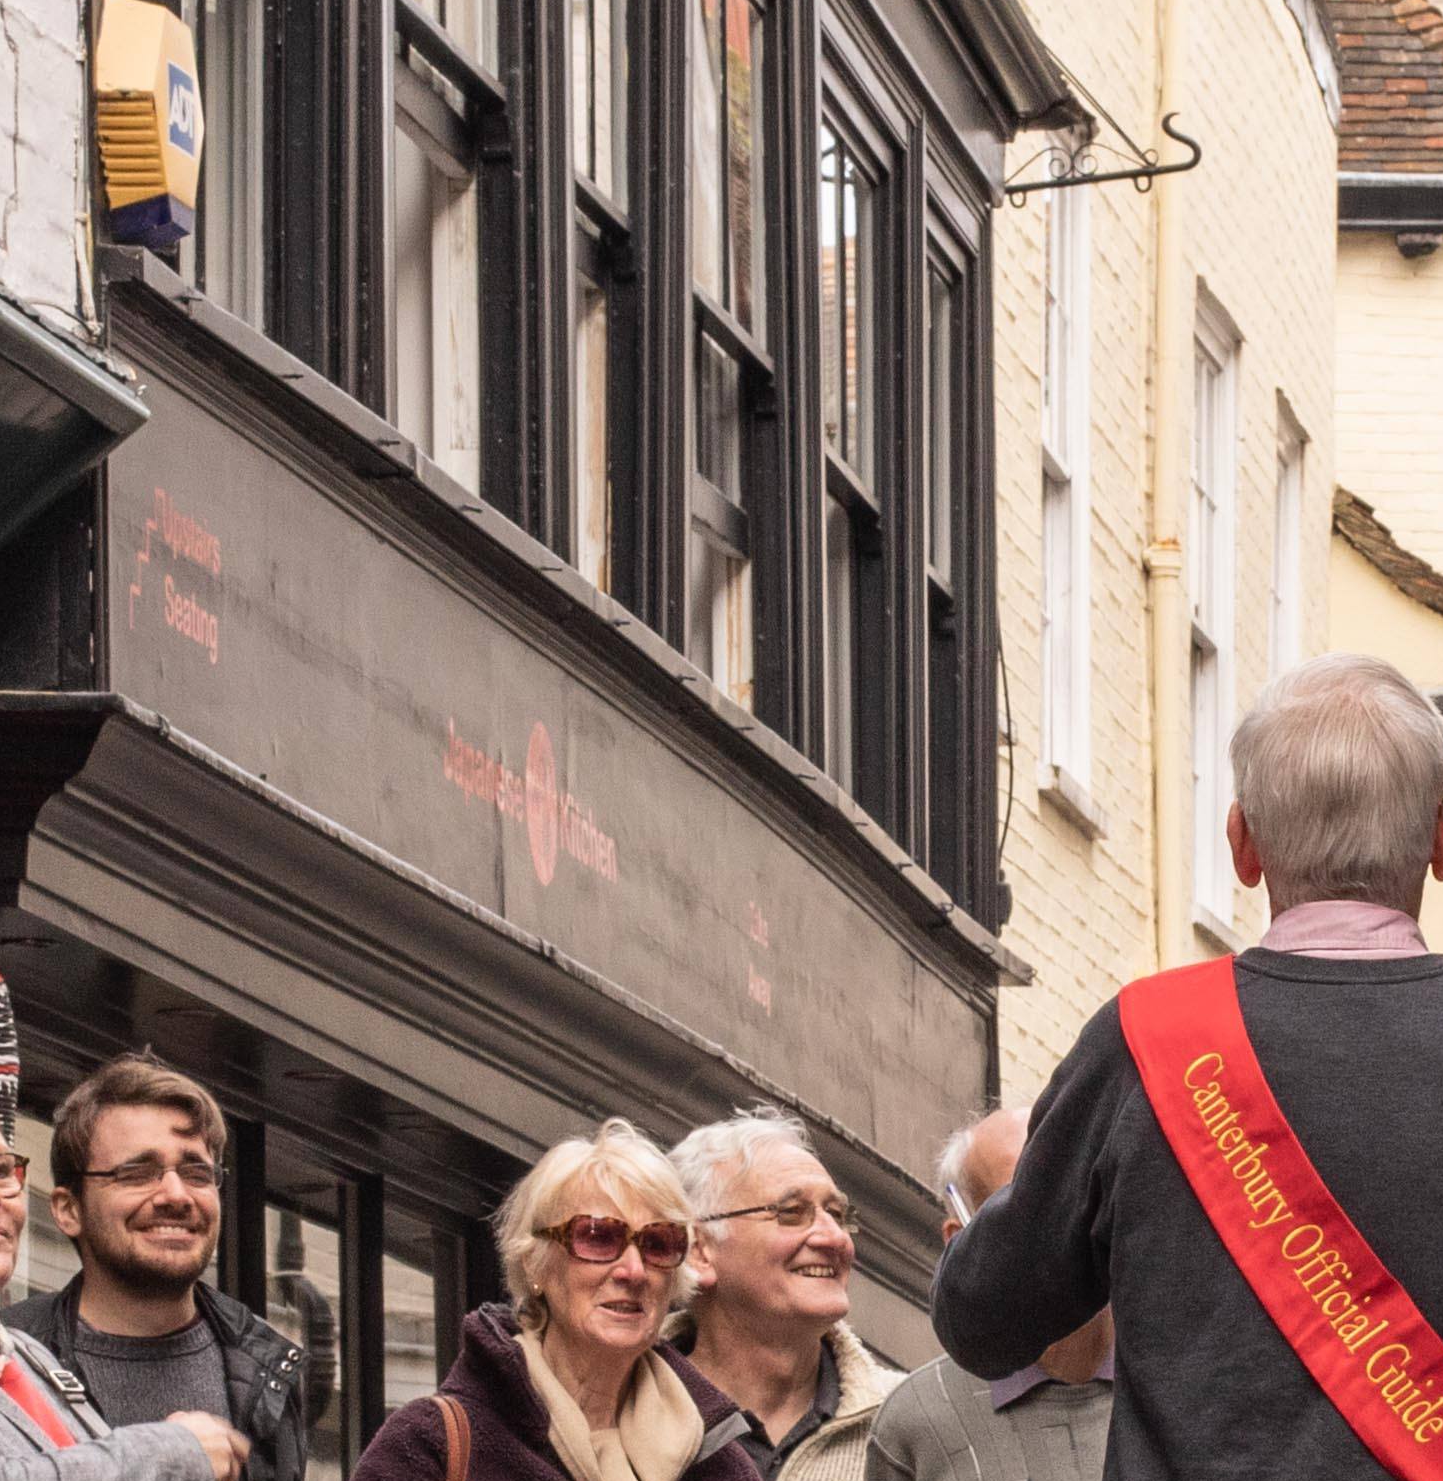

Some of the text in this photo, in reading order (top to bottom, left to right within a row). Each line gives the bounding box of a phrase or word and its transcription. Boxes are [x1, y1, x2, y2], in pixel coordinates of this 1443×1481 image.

[168, 83, 194, 139] ADT
[164, 574, 219, 664] Seating
[443, 717, 620, 885] Japanese Kitchen
[1183, 1052, 1295, 1229] Canterbury
[1281, 1224, 1390, 1354] Official
